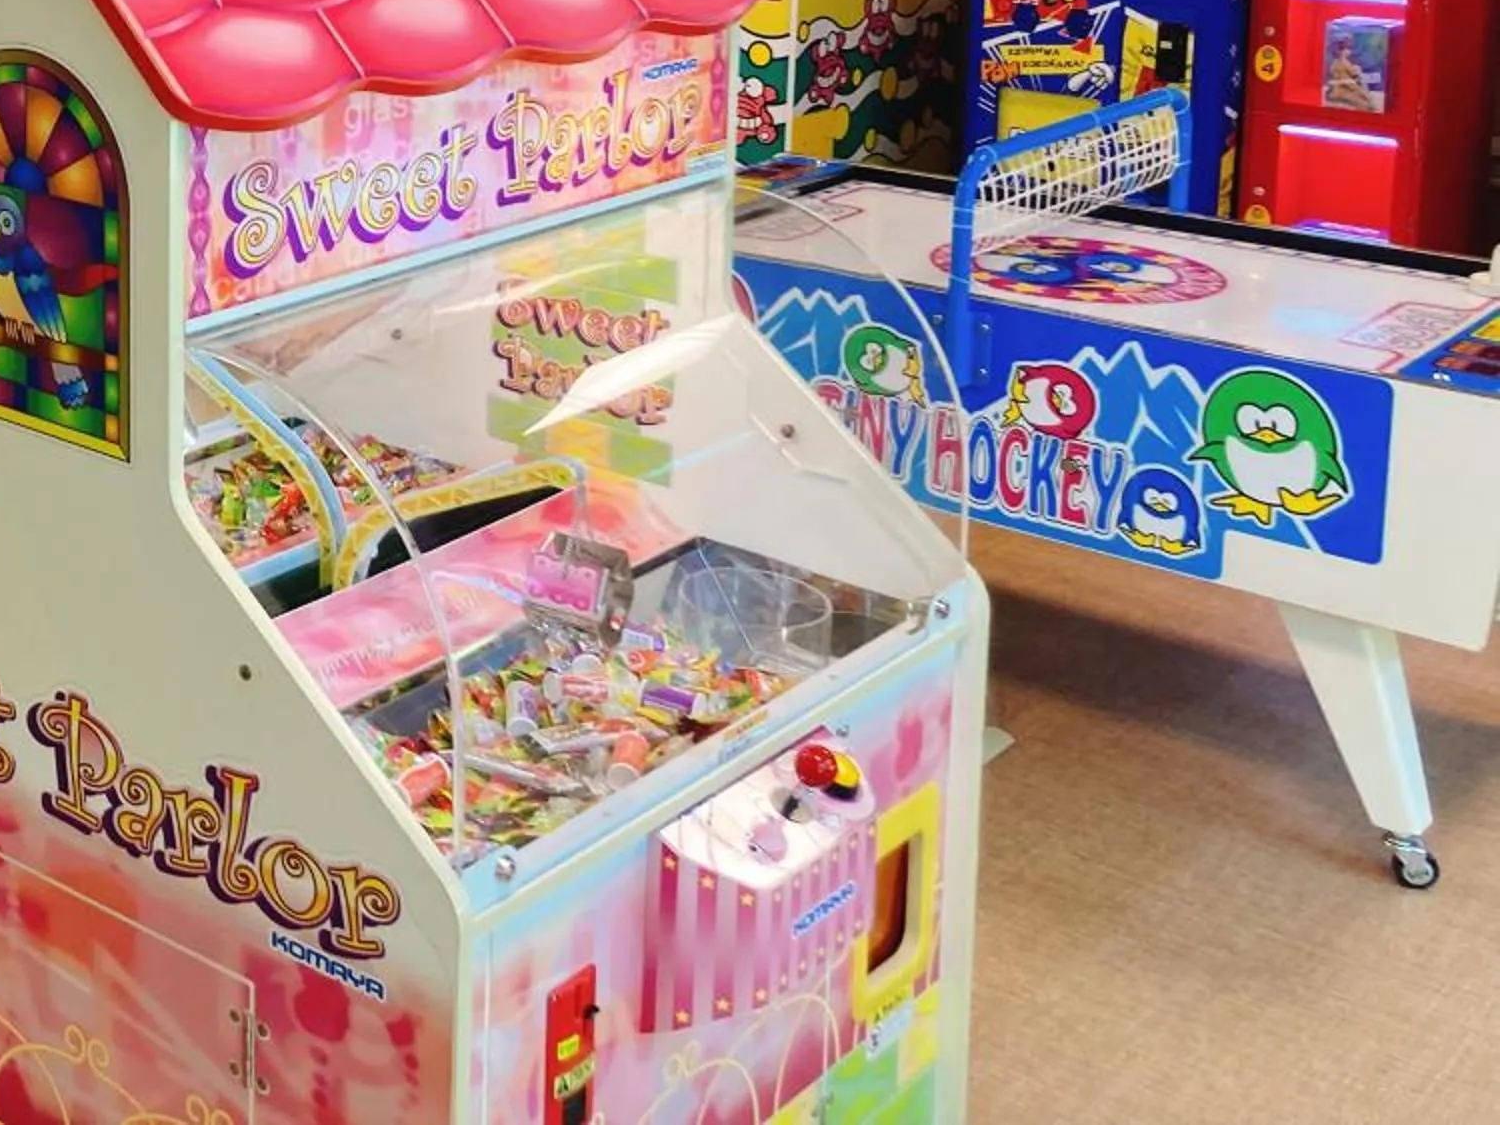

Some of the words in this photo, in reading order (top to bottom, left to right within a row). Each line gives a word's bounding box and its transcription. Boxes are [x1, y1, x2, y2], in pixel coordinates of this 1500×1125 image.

[222, 122, 479, 280] Sweet
[485, 68, 701, 207] Parlor
[930, 405, 1132, 531] HOCKEY
[26, 690, 401, 960] Parlor
[271, 930, 385, 1001] KOMAYA
